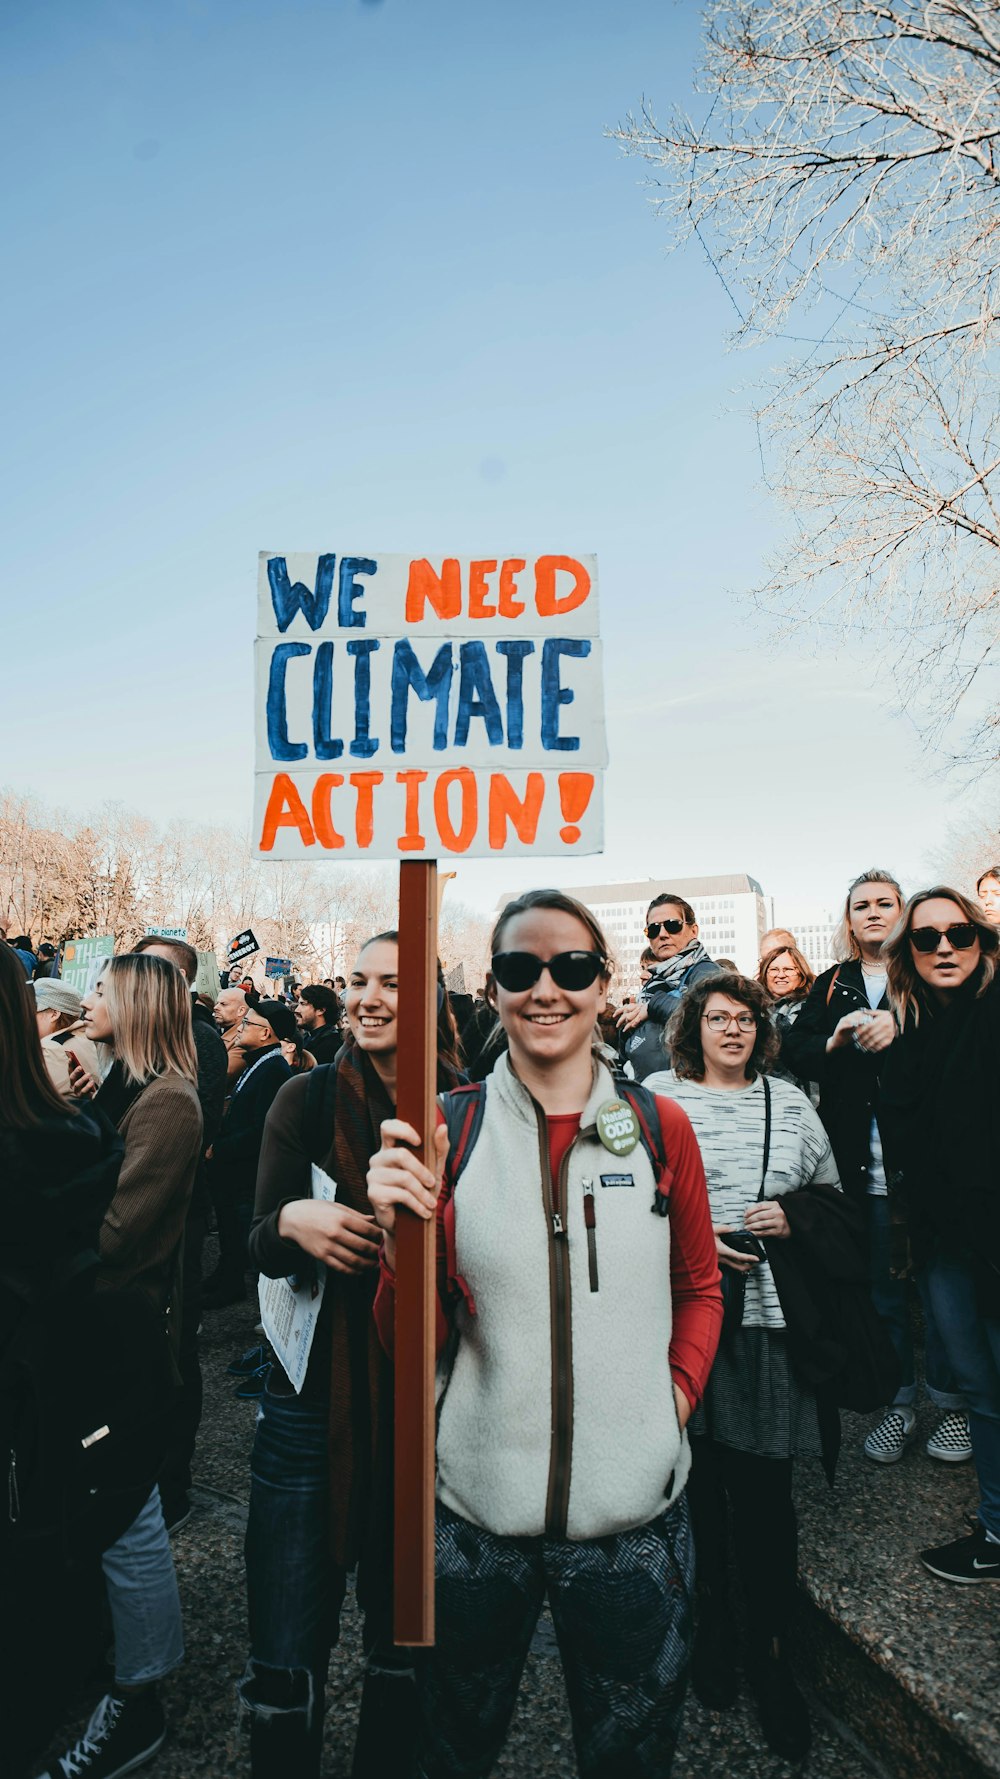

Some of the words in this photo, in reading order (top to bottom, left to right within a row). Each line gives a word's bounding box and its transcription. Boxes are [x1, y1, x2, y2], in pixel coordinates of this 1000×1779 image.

[267, 553, 378, 633] WE
[405, 555, 591, 623] NEED
[266, 637, 592, 762] CLIMATE
[259, 766, 595, 854] ACTION!
[147, 928, 159, 936] The
[75, 941, 104, 965] THE
[228, 942, 256, 960] ENERGY
[64, 968, 88, 991] FUT
[601, 1108, 632, 1124] Natalie
[605, 1120, 634, 1139] ODD
